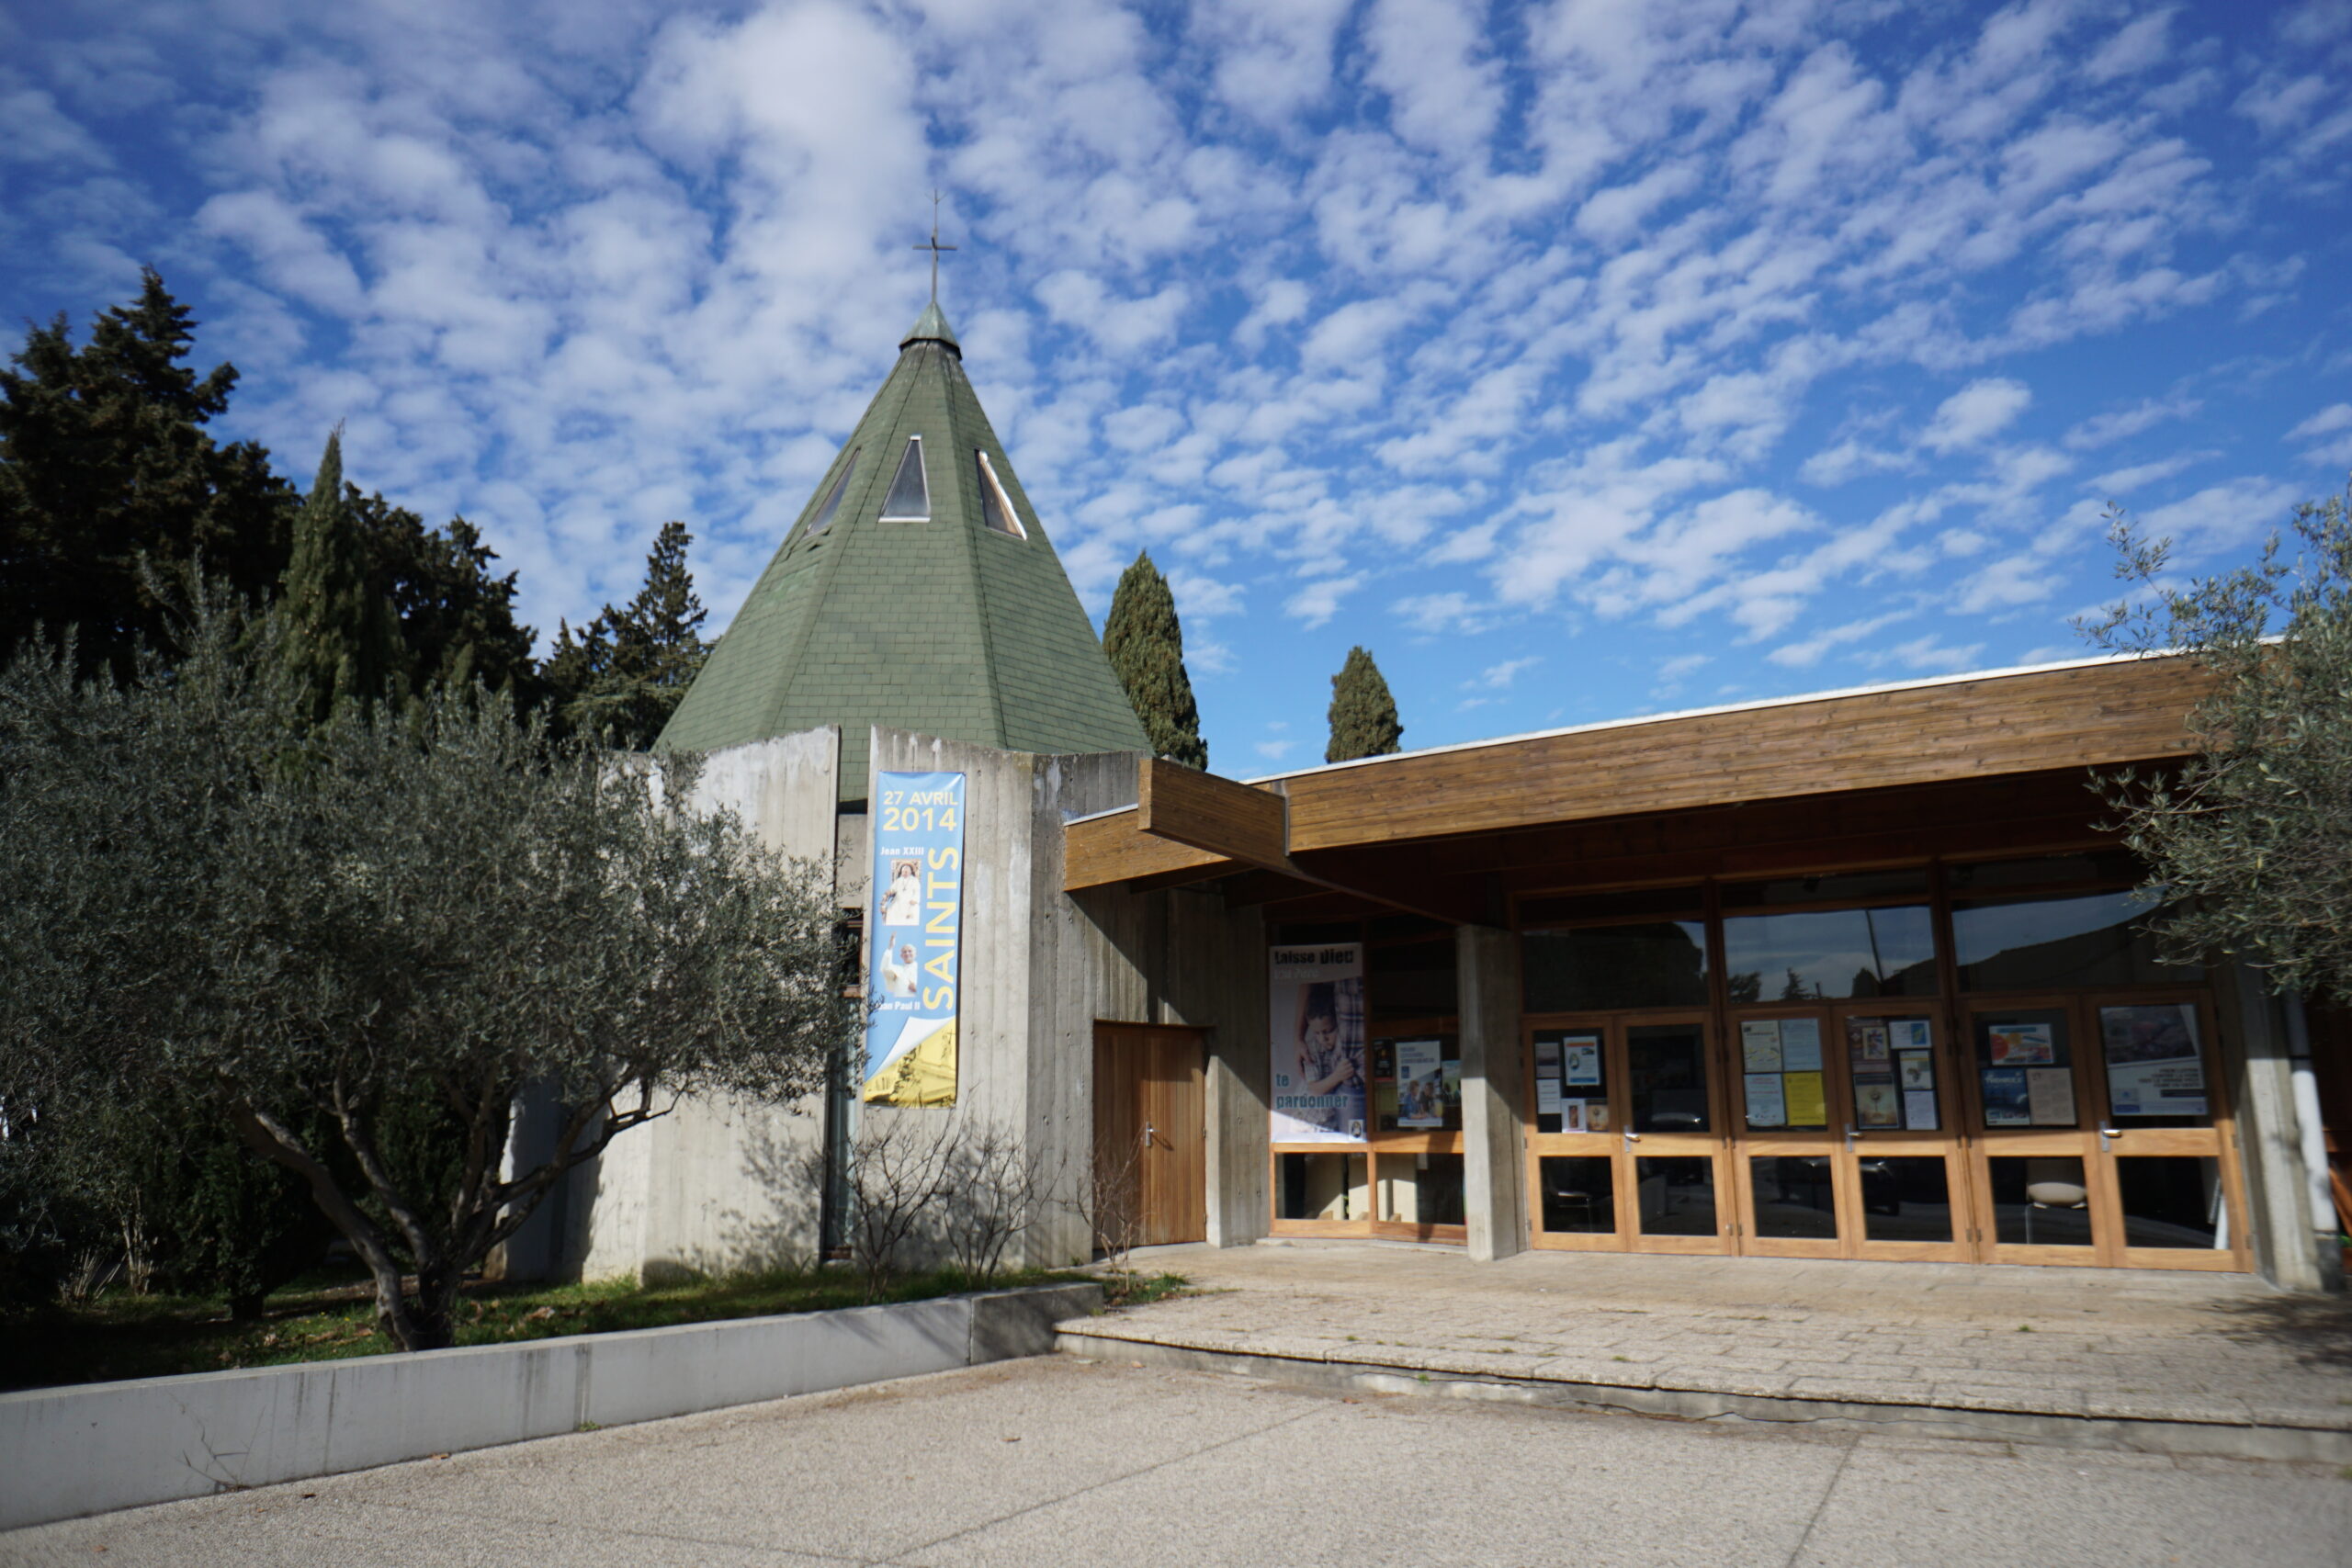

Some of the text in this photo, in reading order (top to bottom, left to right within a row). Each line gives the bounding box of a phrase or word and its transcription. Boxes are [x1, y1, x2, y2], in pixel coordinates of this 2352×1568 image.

[883, 791, 959, 806] 27 AVRIL
[882, 807, 957, 831] 2014
[880, 846, 924, 855] Jean XXIII
[922, 847, 959, 1010] SAINTS
[895, 1001, 913, 1010] Paul
[1276, 1093, 1348, 1110] pardonner
